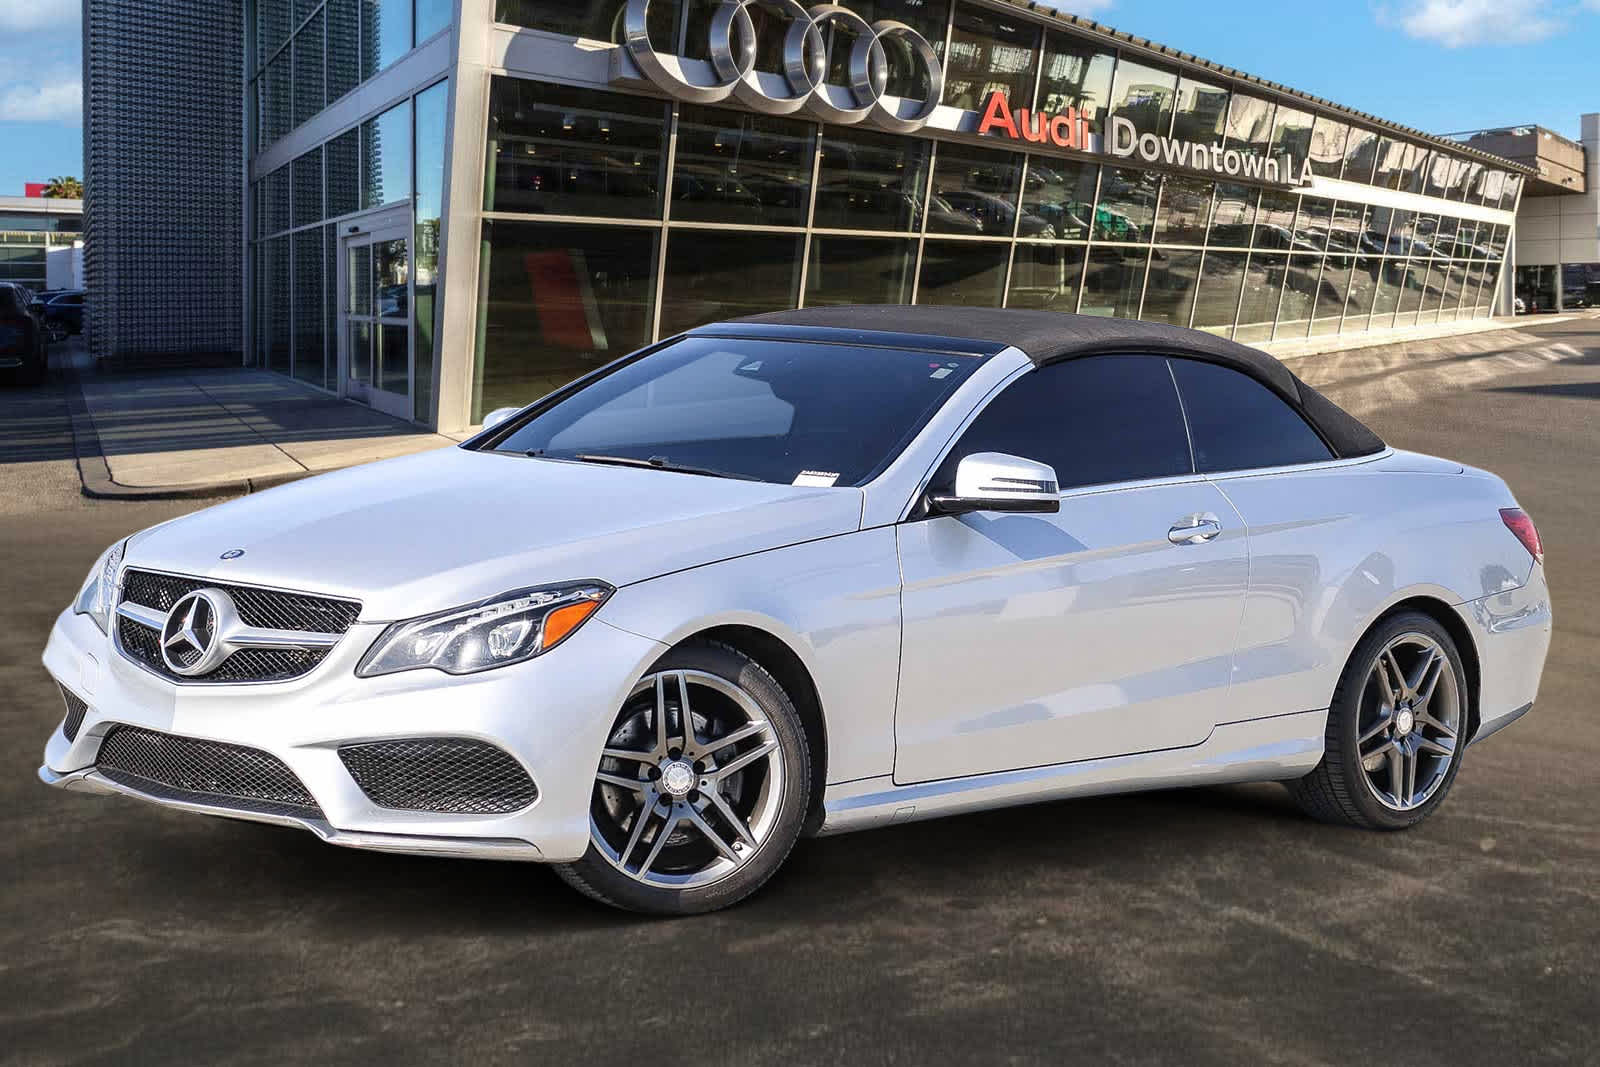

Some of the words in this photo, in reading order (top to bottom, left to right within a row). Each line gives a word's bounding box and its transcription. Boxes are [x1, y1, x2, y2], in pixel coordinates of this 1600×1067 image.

[978, 91, 1089, 150] Audi
[1106, 116, 1280, 183] Downtown
[1283, 154, 1314, 188] LA
